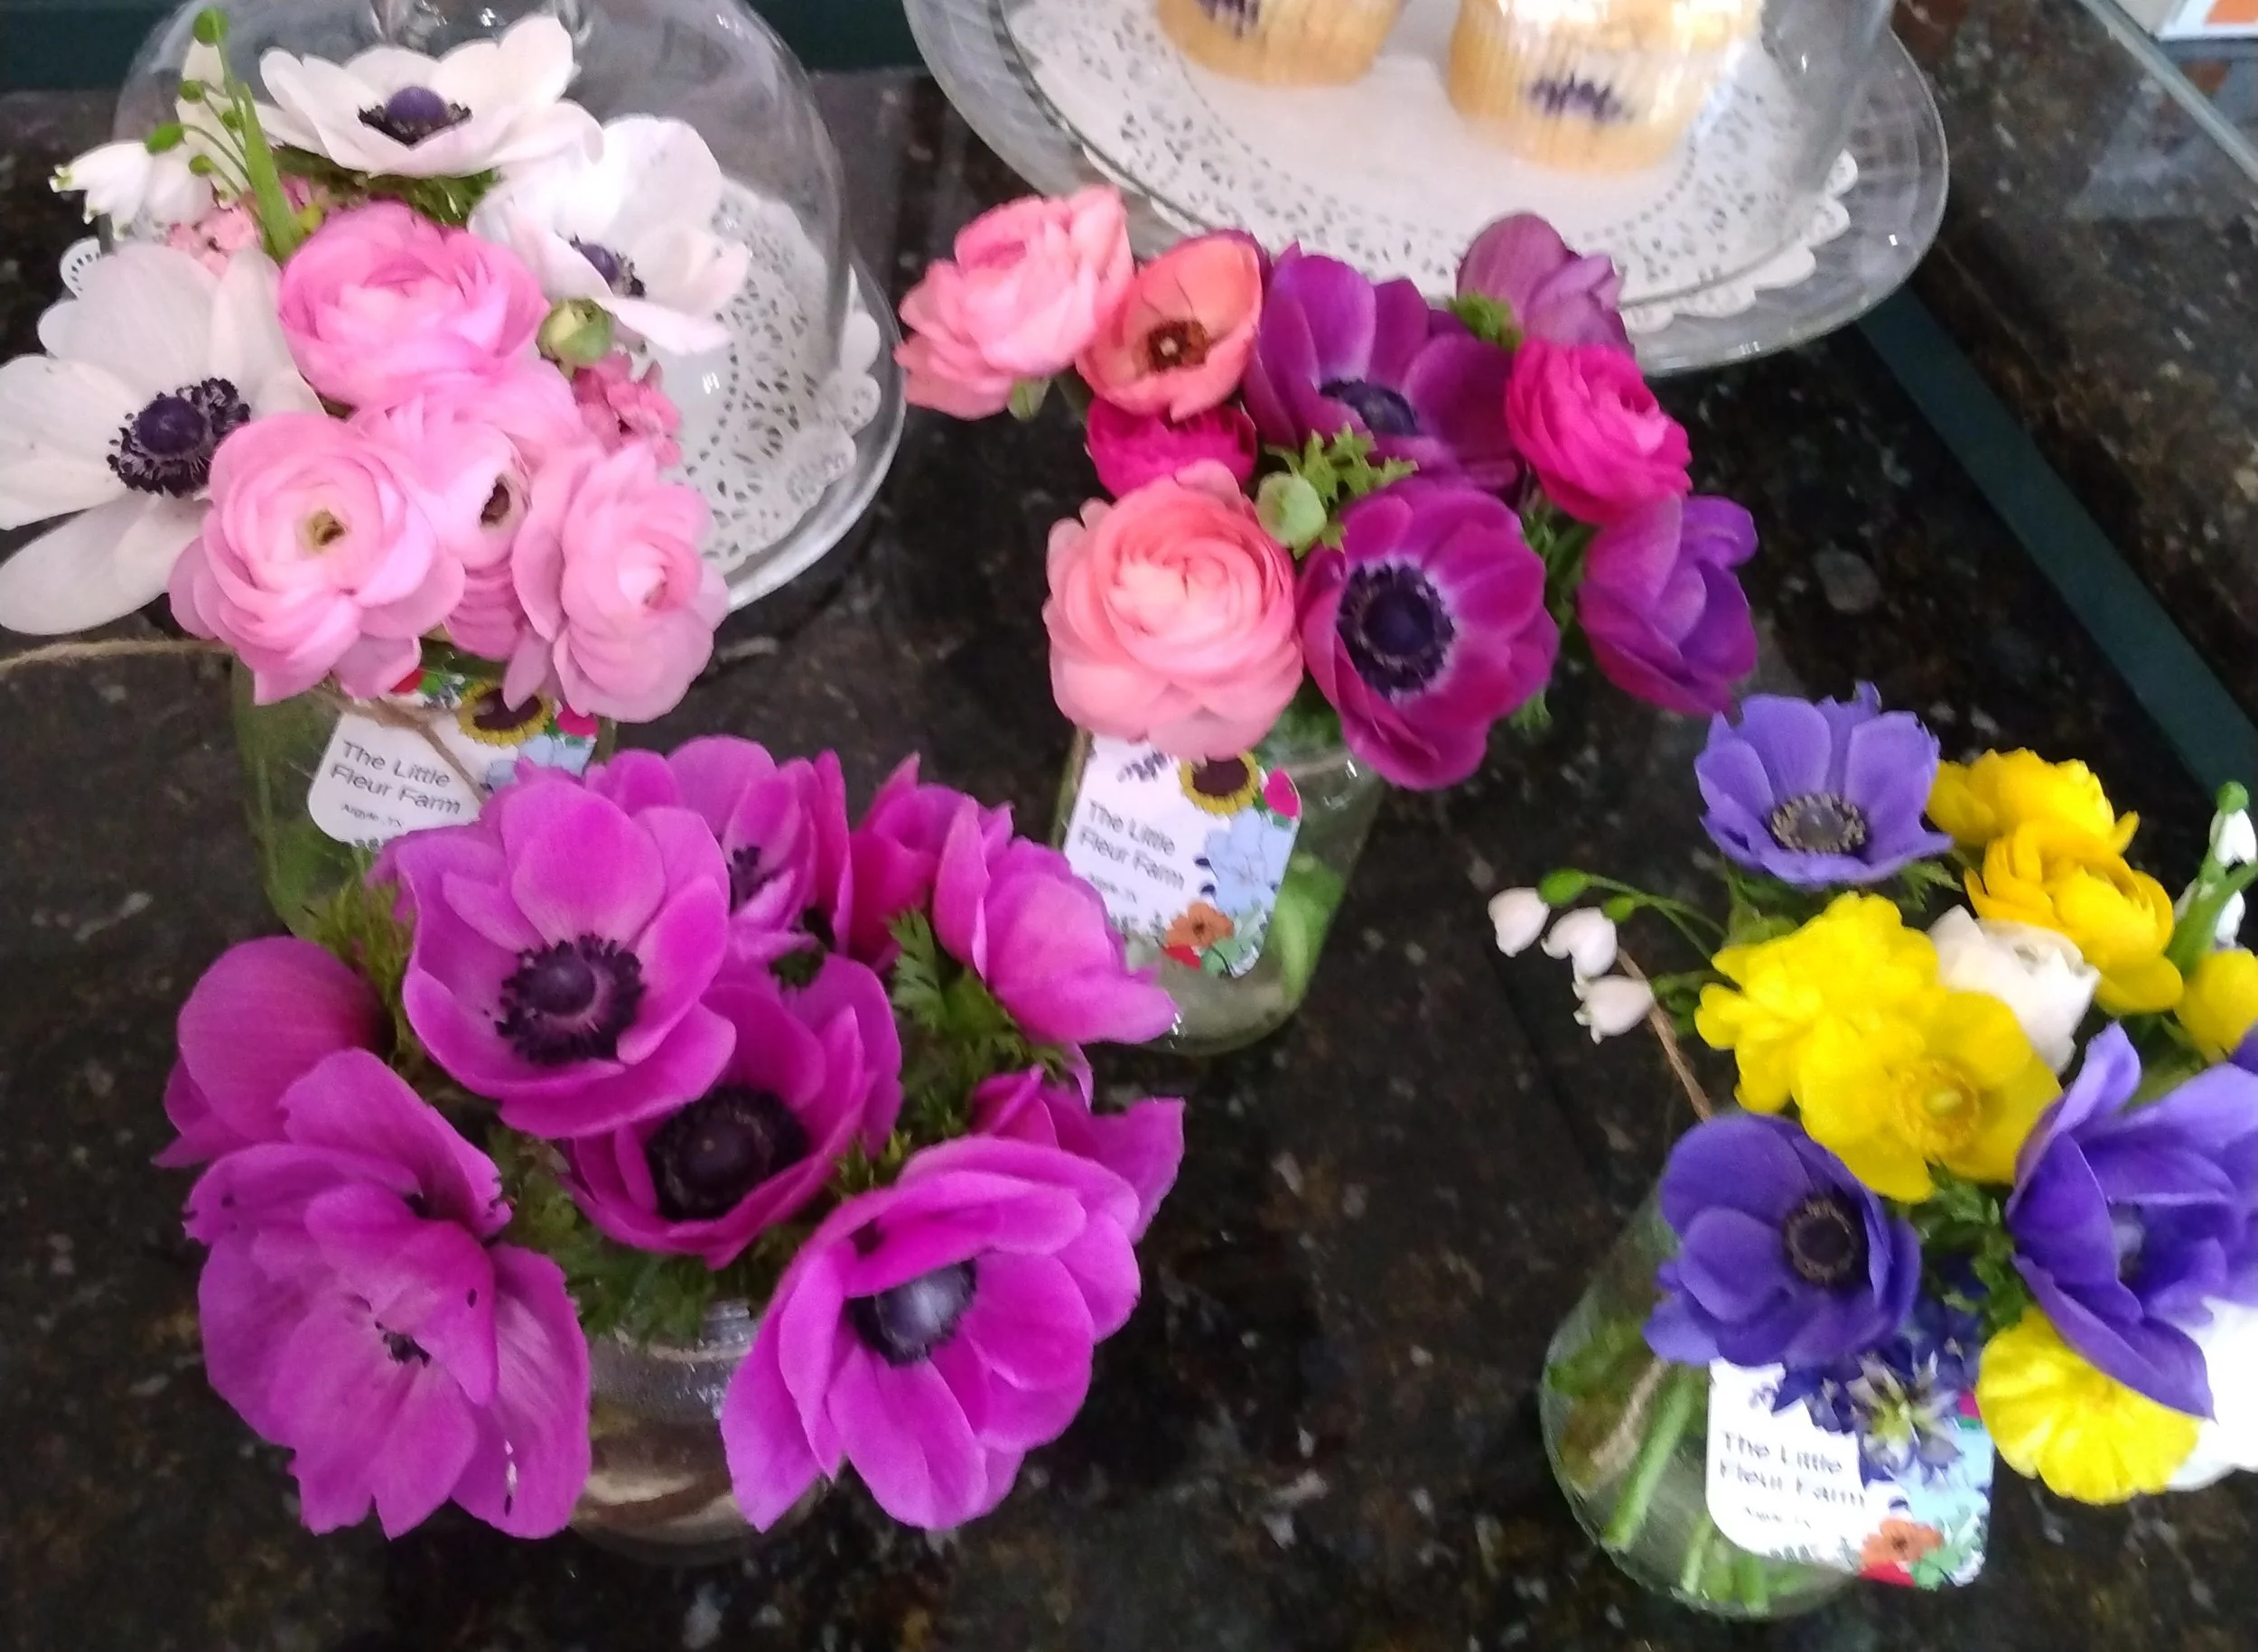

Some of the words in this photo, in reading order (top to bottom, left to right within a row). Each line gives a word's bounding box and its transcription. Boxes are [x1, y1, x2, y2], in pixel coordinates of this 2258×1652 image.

[330, 764, 392, 798] Fleur
[398, 787, 461, 815] Farm
[343, 741, 386, 771] The
[393, 759, 450, 789] Little
[1088, 798, 1124, 833] The
[1129, 817, 1175, 856] Little
[1079, 826, 1129, 864] Fleur
[1133, 848, 1184, 891] Farm
[1721, 1429, 1770, 1459] The
[1779, 1443, 1843, 1475] Little
[1719, 1457, 1783, 1490] Fleur
[1796, 1475, 1866, 1508] Farm
